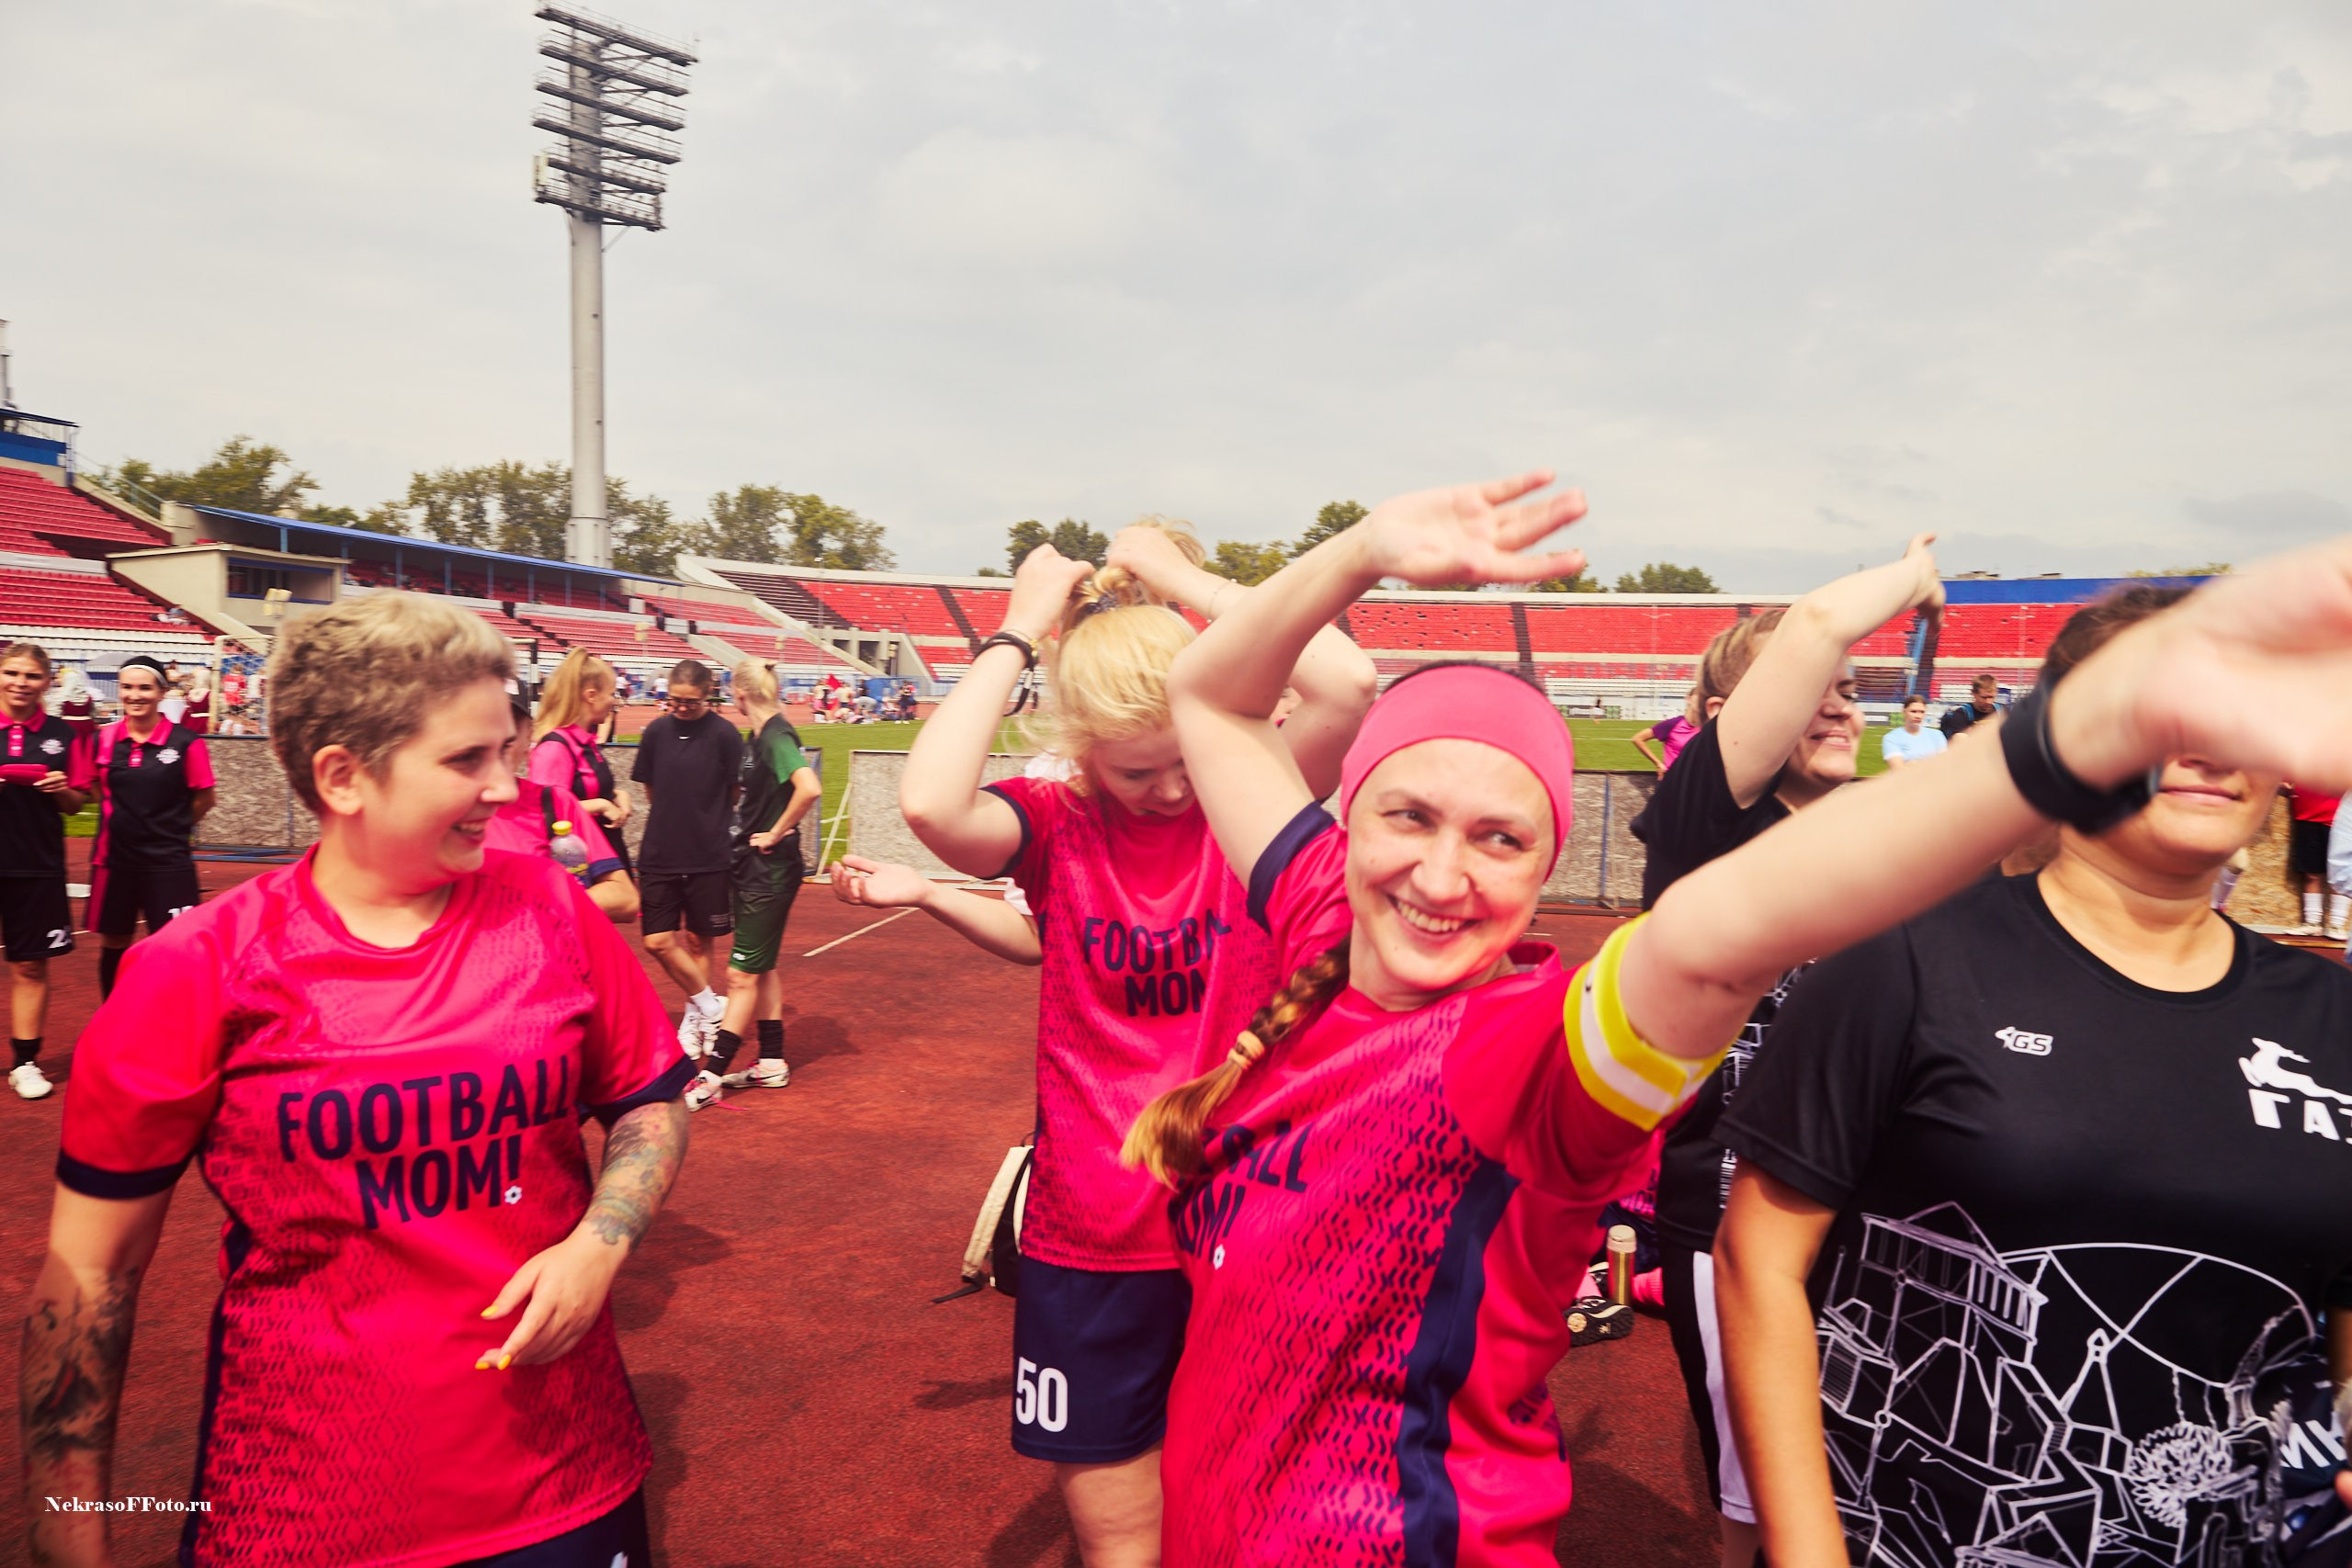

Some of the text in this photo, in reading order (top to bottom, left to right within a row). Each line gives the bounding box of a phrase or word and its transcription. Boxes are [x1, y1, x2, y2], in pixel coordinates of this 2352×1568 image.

[278, 1055, 568, 1162] FOOTBALL
[356, 1134, 522, 1229] MOM!
[1016, 1356, 1068, 1432] 50
